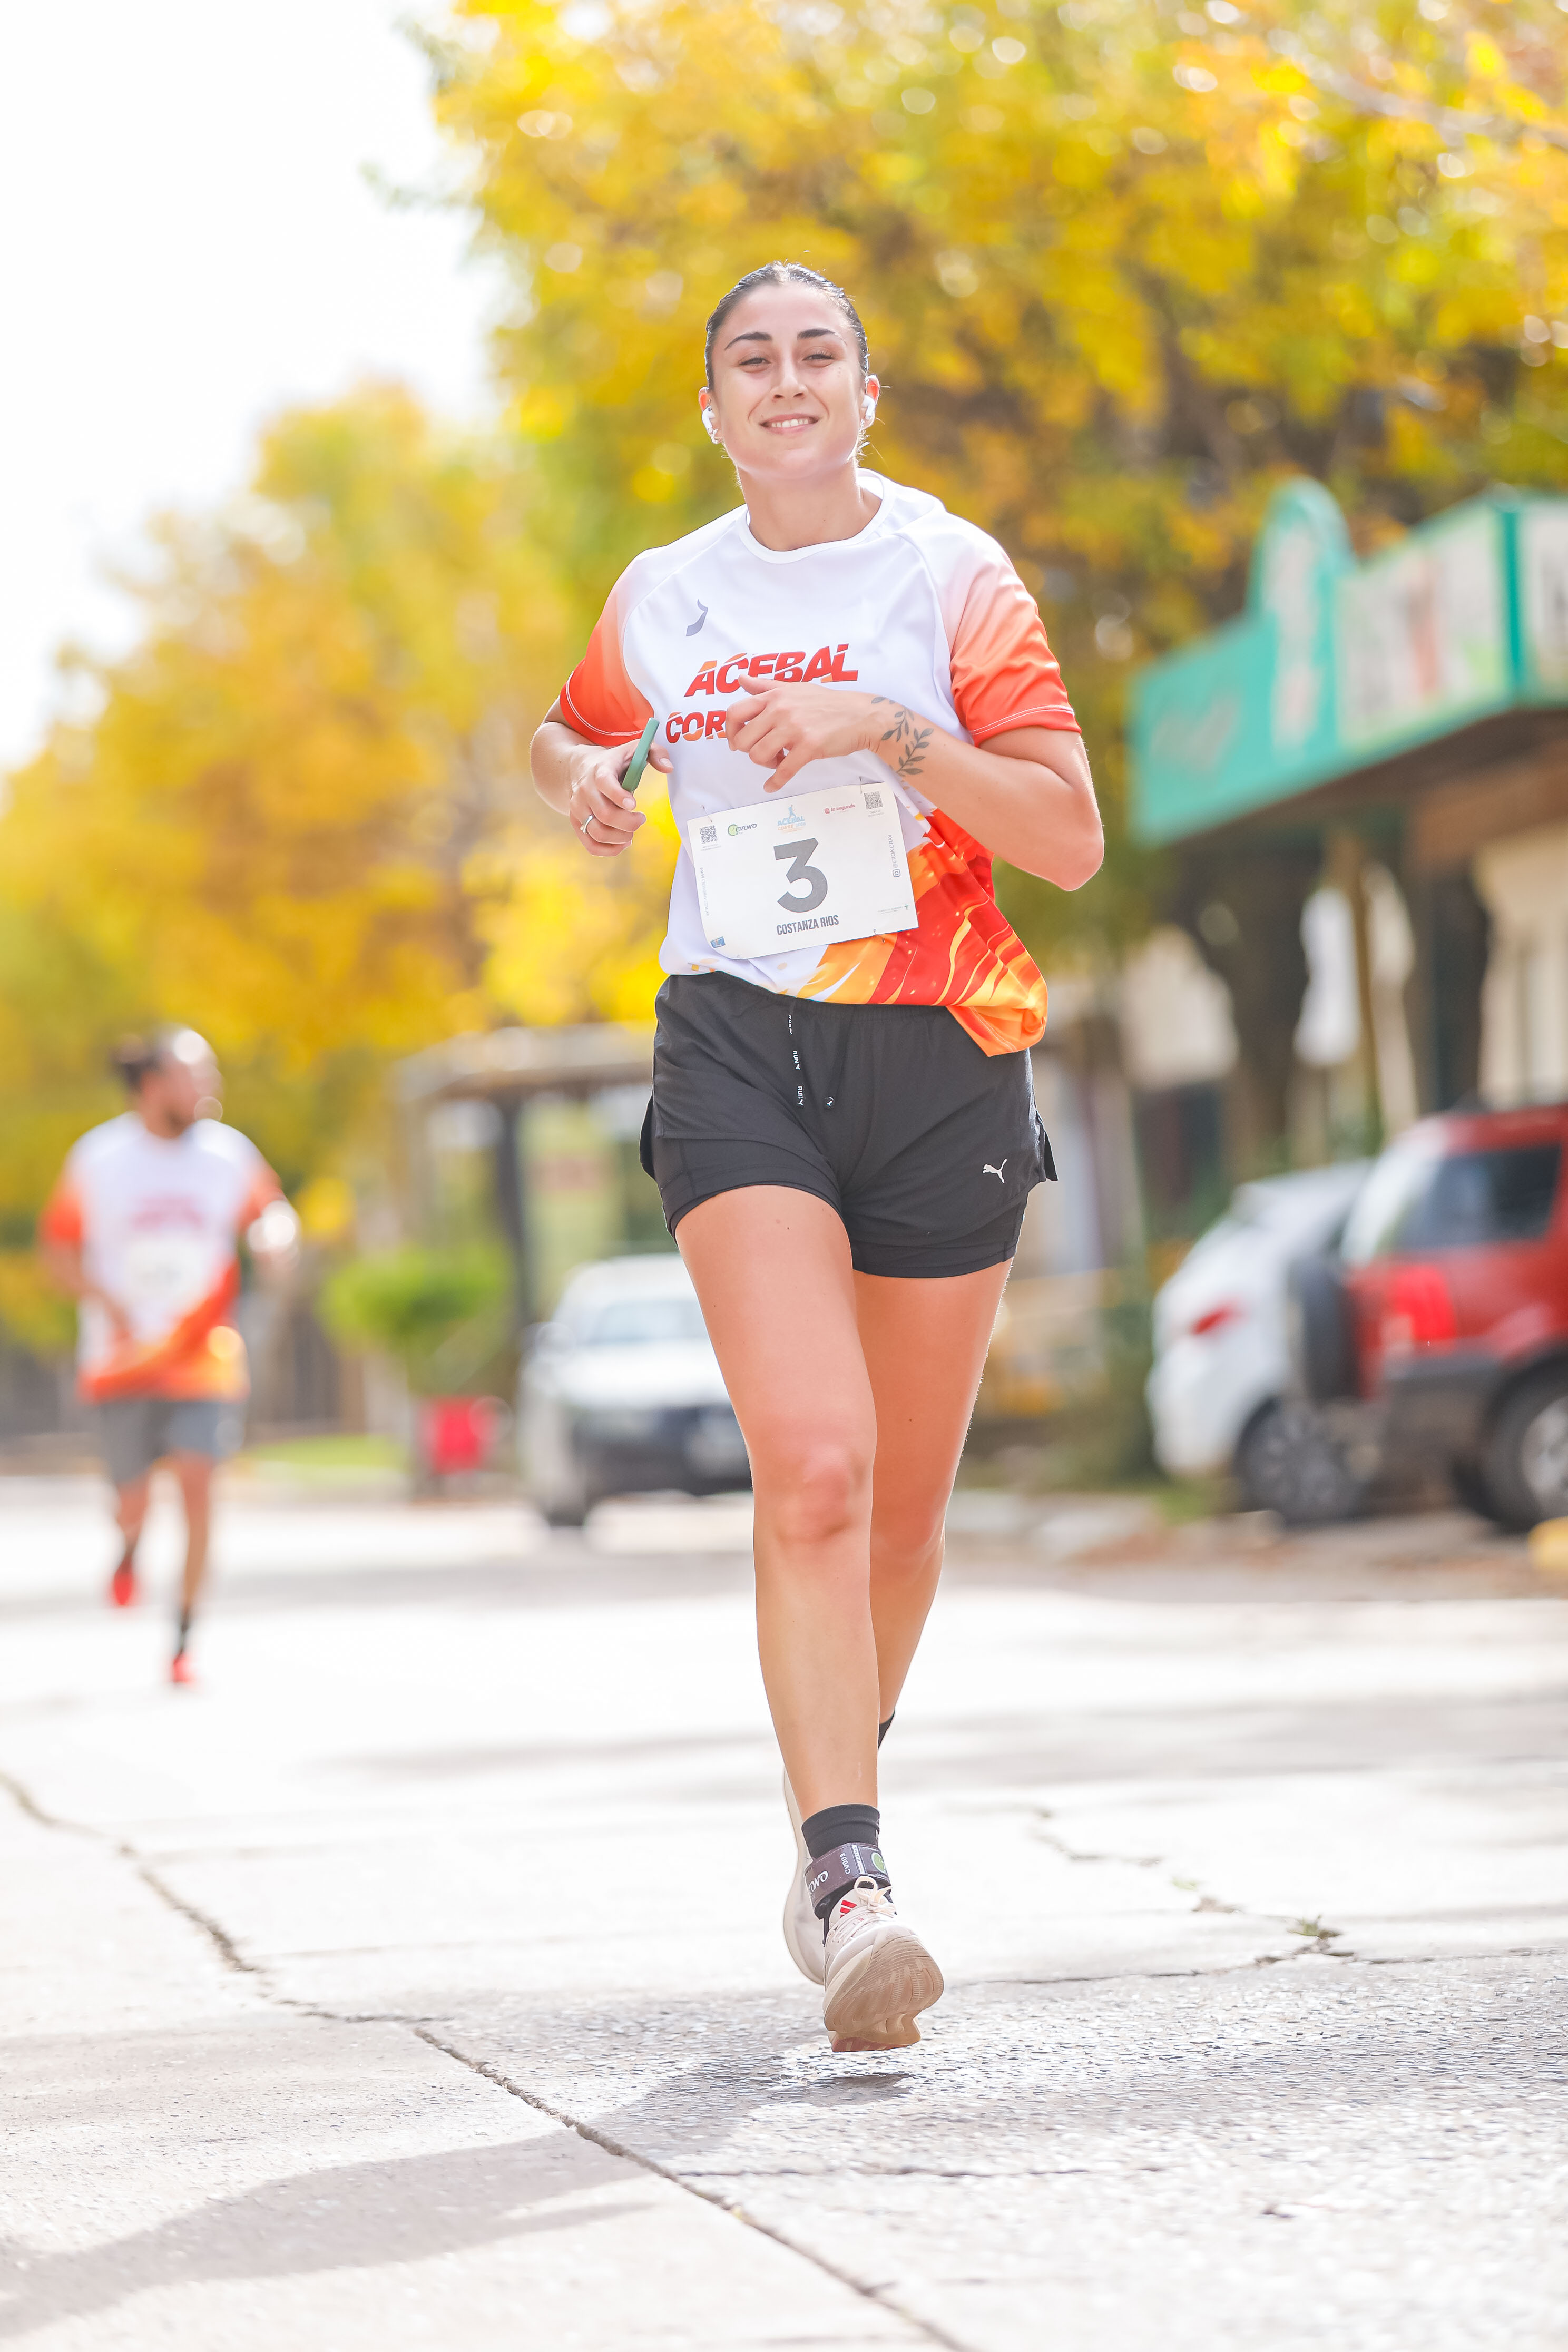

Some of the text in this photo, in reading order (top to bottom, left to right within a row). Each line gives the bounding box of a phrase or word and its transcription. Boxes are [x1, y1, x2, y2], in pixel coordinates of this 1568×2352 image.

[665, 710, 727, 744] COR
[887, 834, 898, 868] @CRONORAV
[773, 838, 828, 913] 3
[776, 914, 839, 936] COSTANZA RIOS
[840, 1853, 851, 1874] CV003
[808, 1871, 828, 1892] ONO
